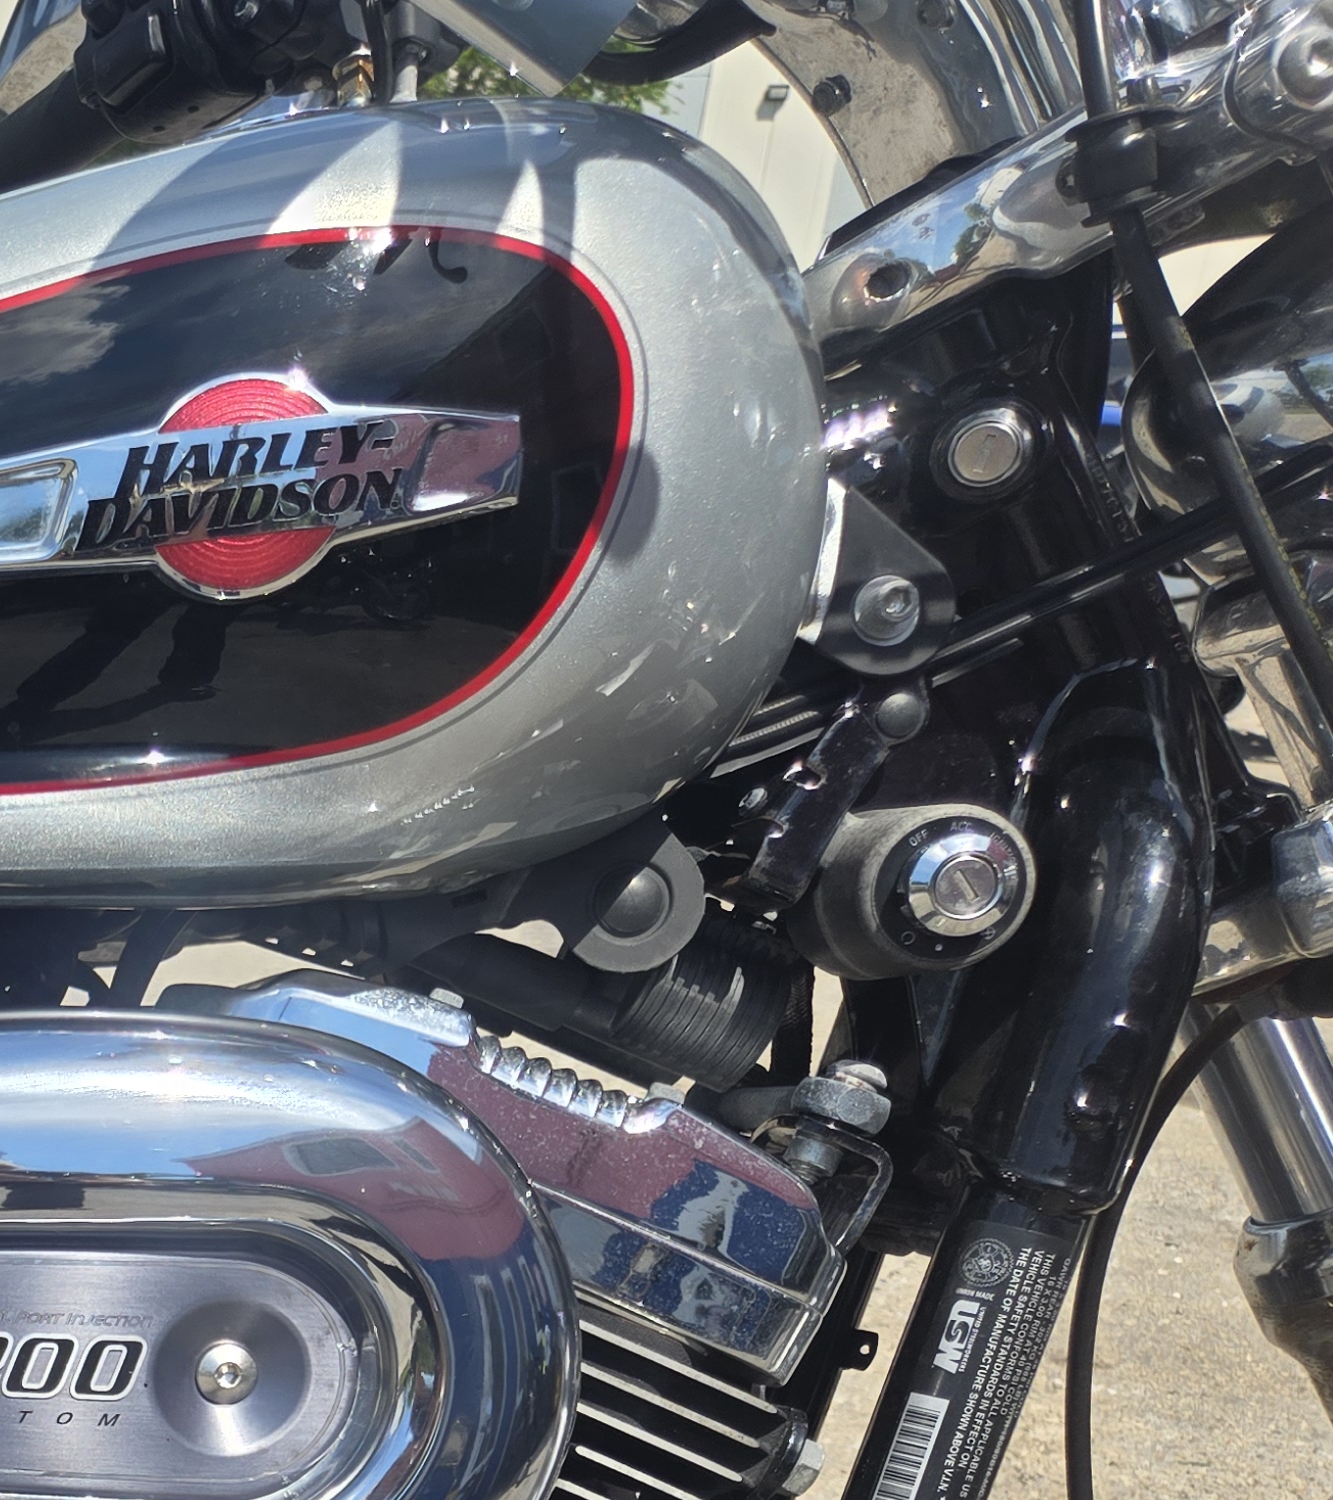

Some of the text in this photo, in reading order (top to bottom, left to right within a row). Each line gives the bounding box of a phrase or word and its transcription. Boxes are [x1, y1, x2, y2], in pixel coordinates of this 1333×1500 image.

[113, 422, 394, 497] HARLEY-
[73, 468, 403, 552] DAVIDSON
[909, 829, 928, 847] OFF
[950, 821, 973, 831] ACC
[1040, 1254, 1055, 1275] THIS
[1023, 1278, 1045, 1321] VEHICLE
[934, 1299, 979, 1372] USW
[1022, 1338, 1032, 1353] AT
[944, 1247, 1031, 1466] THE DATE OF MANUFACTURE SHOWN ABOVE
[957, 1250, 1044, 1468] VEHICLE SAFETY STANDARDS IN EFFECT ON
[1002, 1323, 1028, 1380] CONFORMS
[996, 1383, 1007, 1397] TO
[999, 1386, 1015, 1415] COLD
[987, 1397, 1001, 1417] ALL
[965, 1419, 993, 1481] APPLICABLE
[936, 1468, 954, 1492] V.I.N.
[959, 1483, 970, 1497] US
